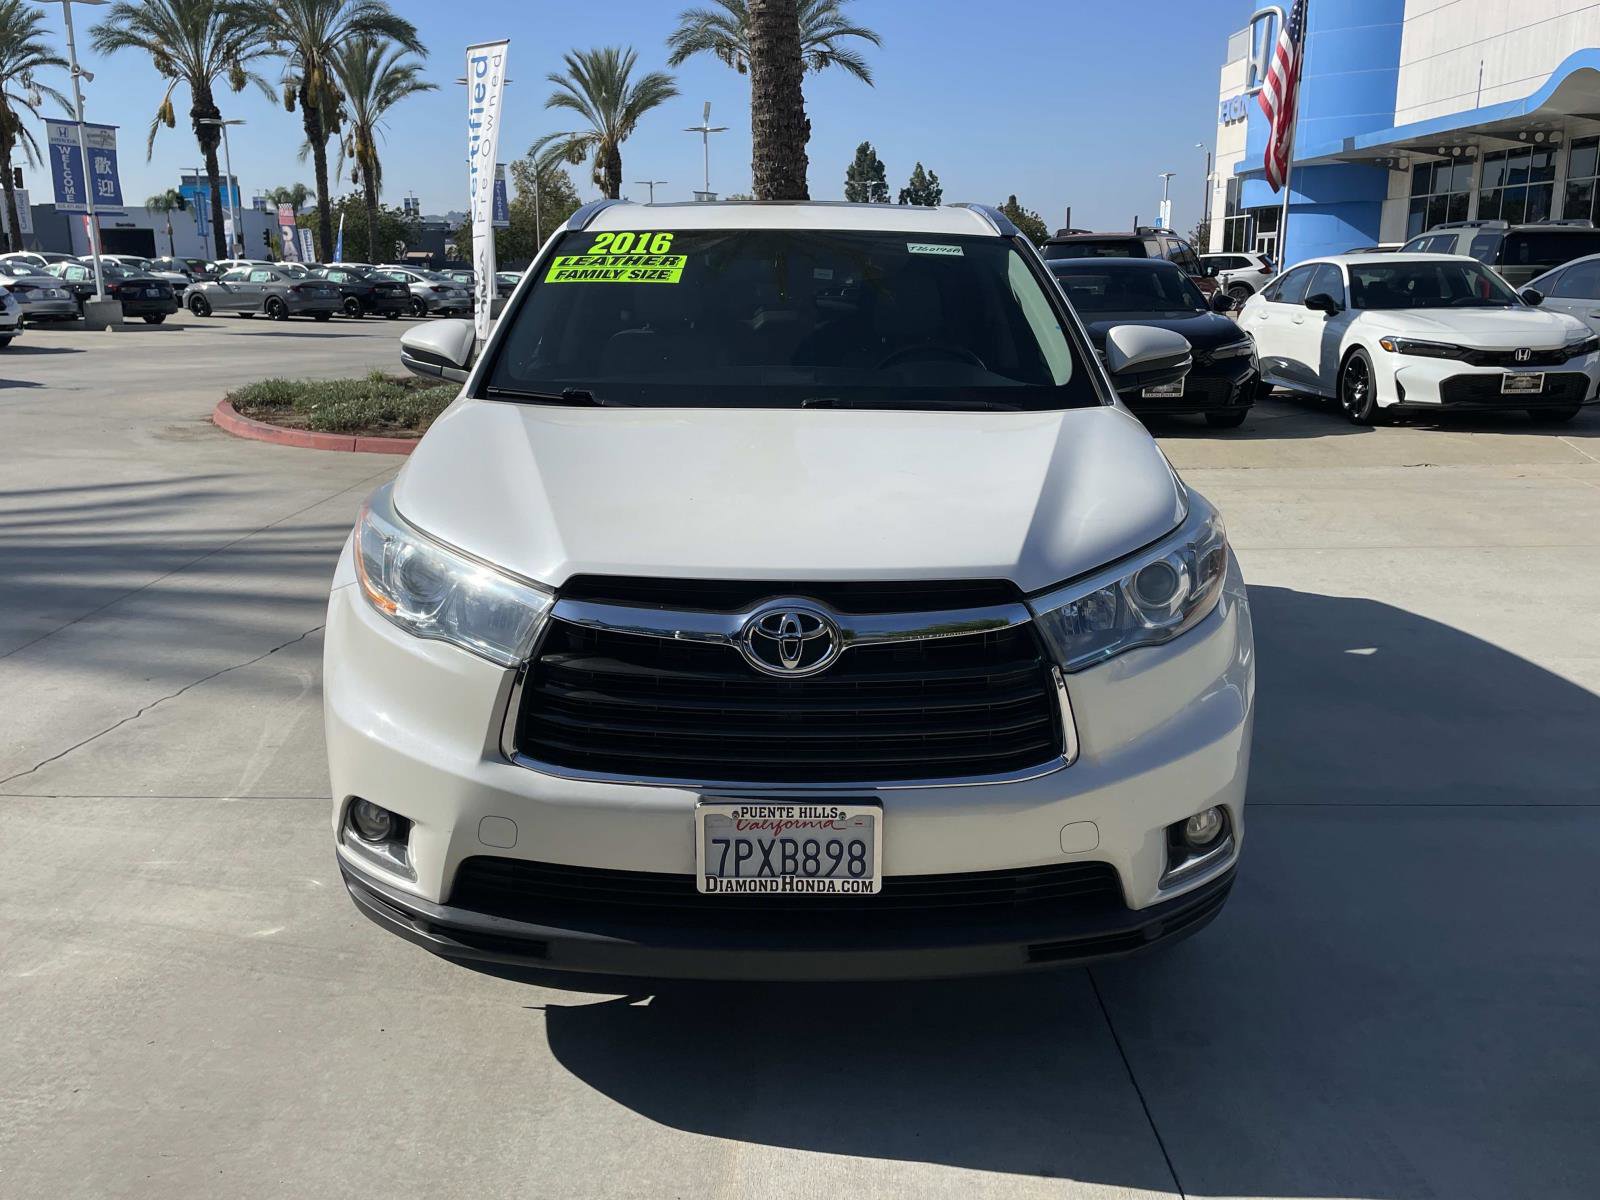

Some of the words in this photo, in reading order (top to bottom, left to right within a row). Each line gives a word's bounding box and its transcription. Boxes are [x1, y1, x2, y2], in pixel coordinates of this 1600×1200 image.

[56, 145, 76, 202] WELCOME
[587, 232, 674, 255] 2016
[557, 256, 682, 267] LEATHER
[555, 270, 624, 280] FAMILY
[628, 270, 673, 280] SIZE
[740, 807, 794, 819] PUENTE
[799, 807, 838, 819] HILLS
[736, 820, 847, 836] California
[712, 839, 867, 877] 7PXB898
